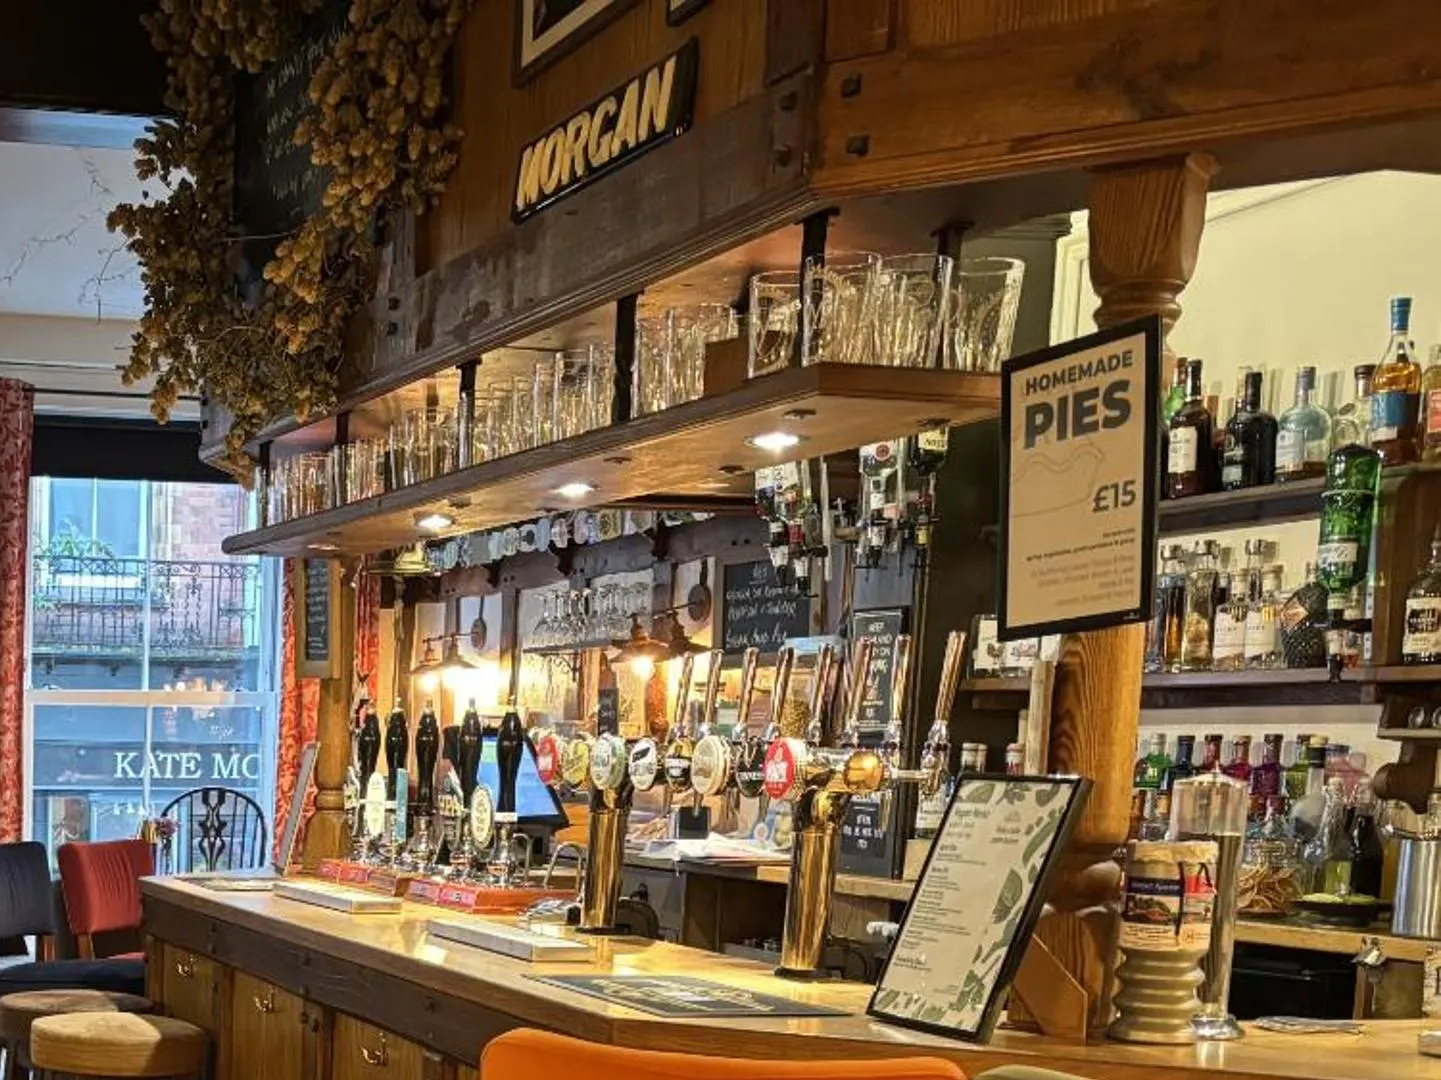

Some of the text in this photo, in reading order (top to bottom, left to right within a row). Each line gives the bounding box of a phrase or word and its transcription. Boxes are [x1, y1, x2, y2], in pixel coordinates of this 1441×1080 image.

[516, 55, 677, 212] MORGAN
[1024, 350, 1134, 397] HOMEMADE
[1024, 379, 1133, 450] PIES
[1092, 479, 1137, 513] £15
[113, 752, 202, 779] KATE
